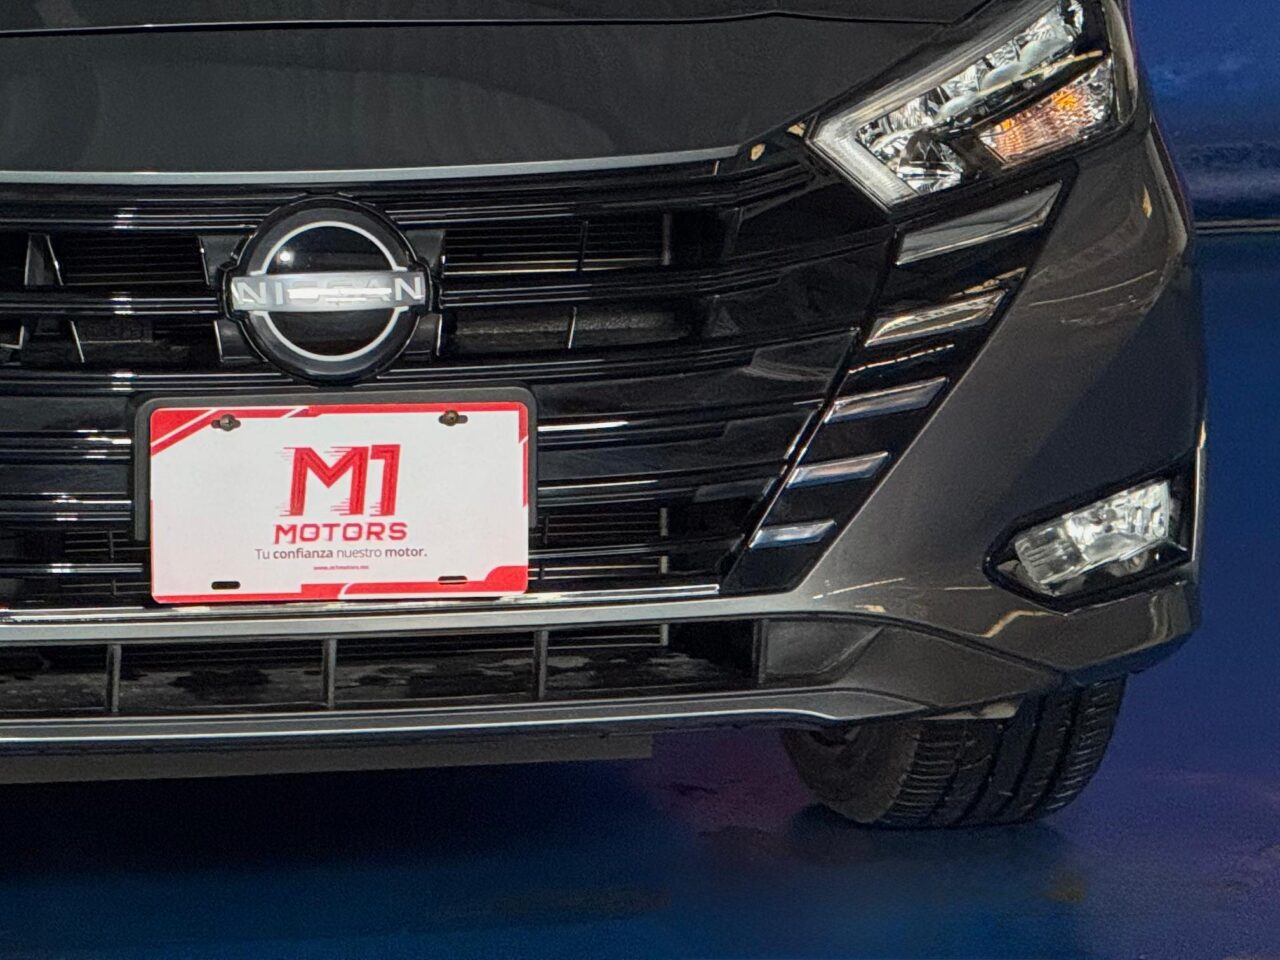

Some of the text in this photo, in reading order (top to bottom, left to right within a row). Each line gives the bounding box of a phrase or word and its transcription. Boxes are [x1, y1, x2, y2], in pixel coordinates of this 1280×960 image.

[284, 443, 401, 517] M1
[273, 521, 408, 545] MOTORS
[255, 546, 428, 560] Tu confianza nuestro motor.
